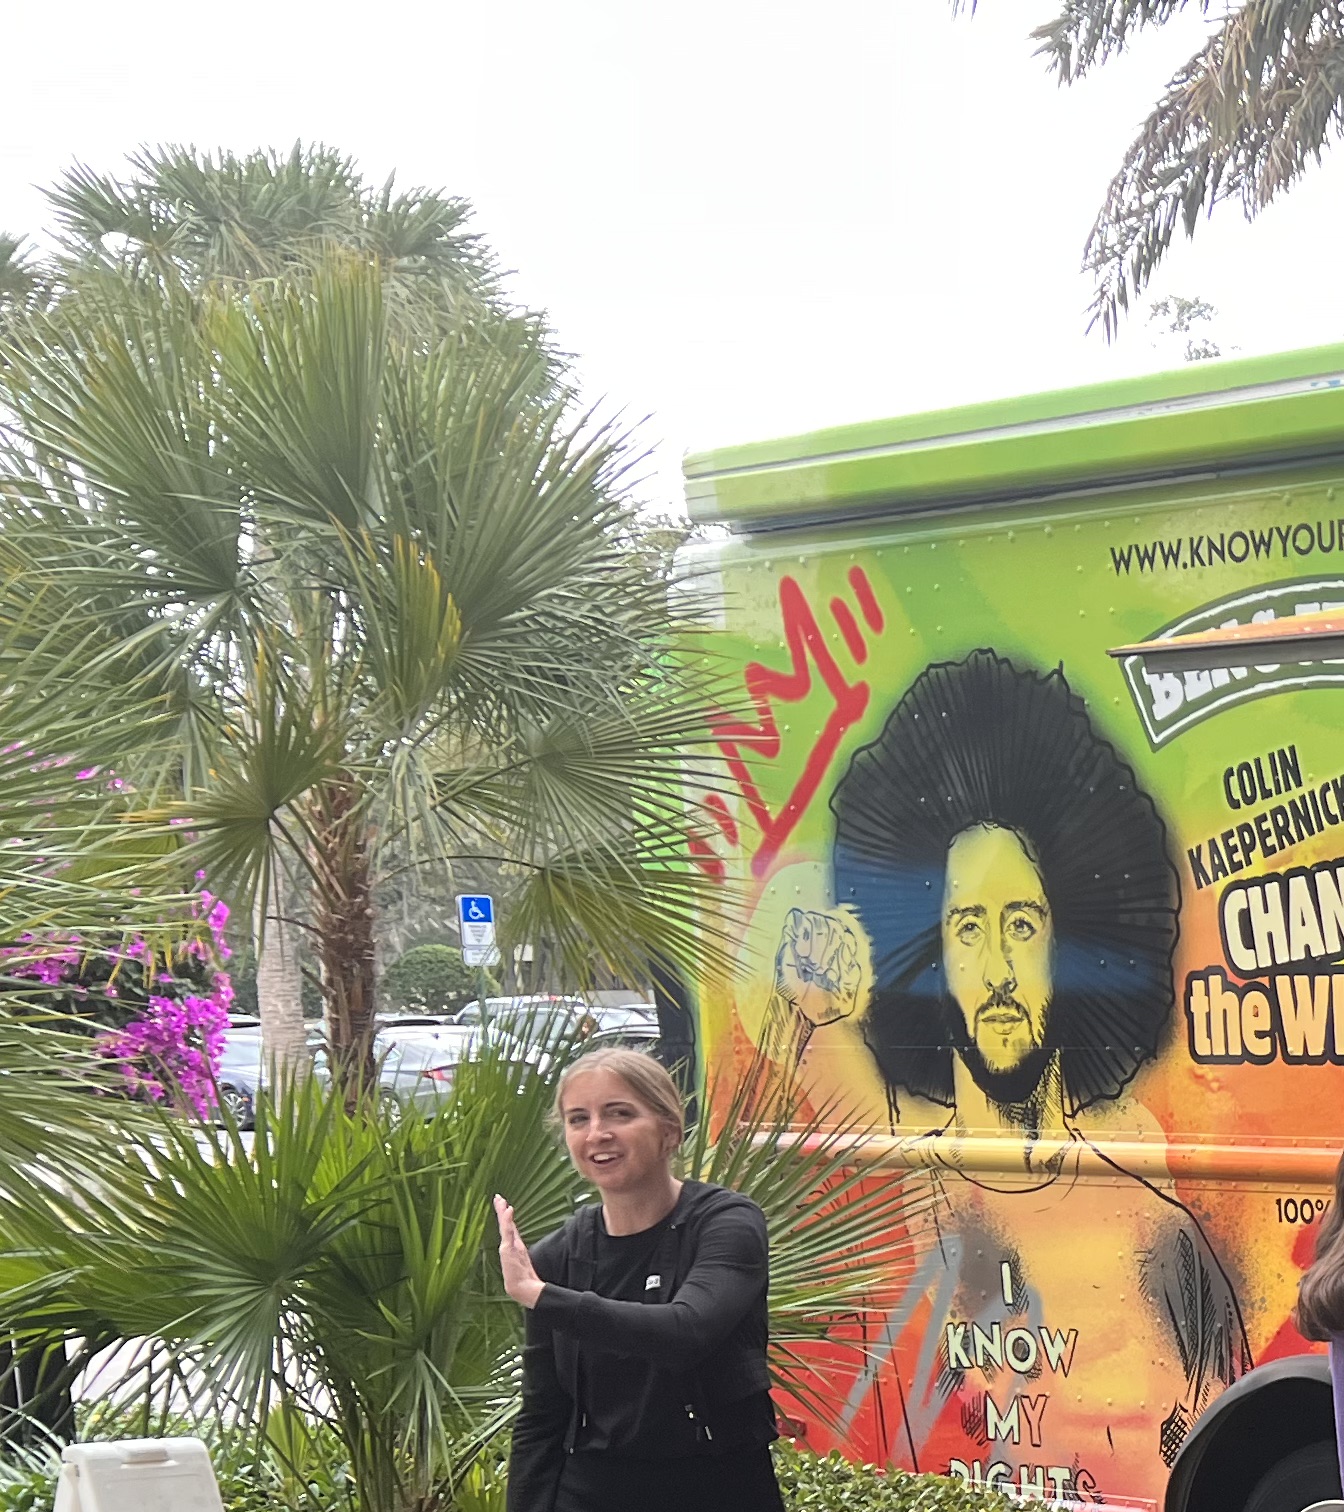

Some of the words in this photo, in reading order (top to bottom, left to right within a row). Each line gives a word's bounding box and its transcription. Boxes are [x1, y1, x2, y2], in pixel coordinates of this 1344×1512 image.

[1222, 744, 1303, 810] COLIN
[1189, 973, 1272, 1056] the
[1000, 1260, 1014, 1306] I
[945, 1321, 1078, 1378] KNOW
[984, 1390, 1049, 1448] MY
